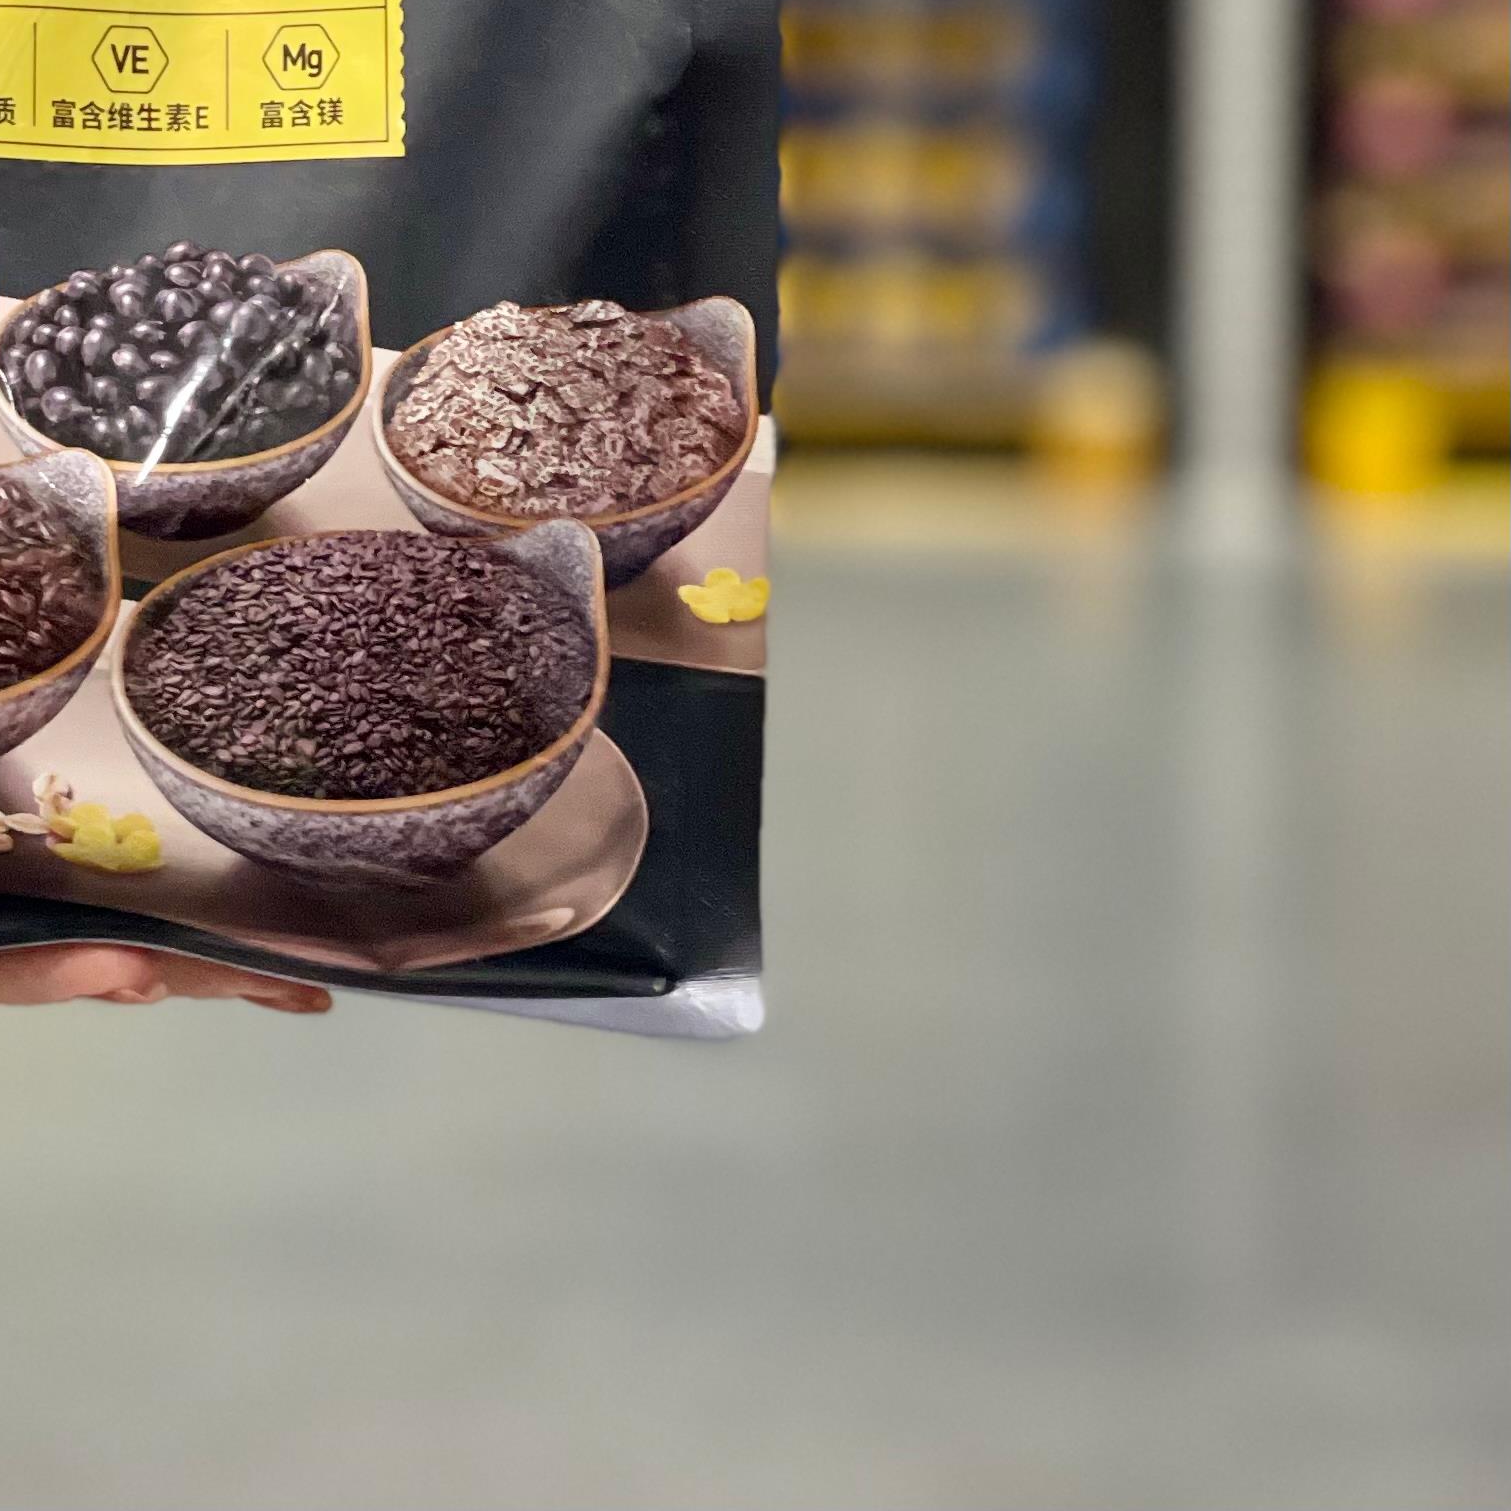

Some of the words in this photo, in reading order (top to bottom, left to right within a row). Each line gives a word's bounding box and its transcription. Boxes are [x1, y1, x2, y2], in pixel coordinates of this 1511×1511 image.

[111, 44, 150, 74] VE
[283, 43, 323, 78] Mg
[51, 99, 209, 133] 富含维生素E
[260, 97, 344, 130] 富含镁
